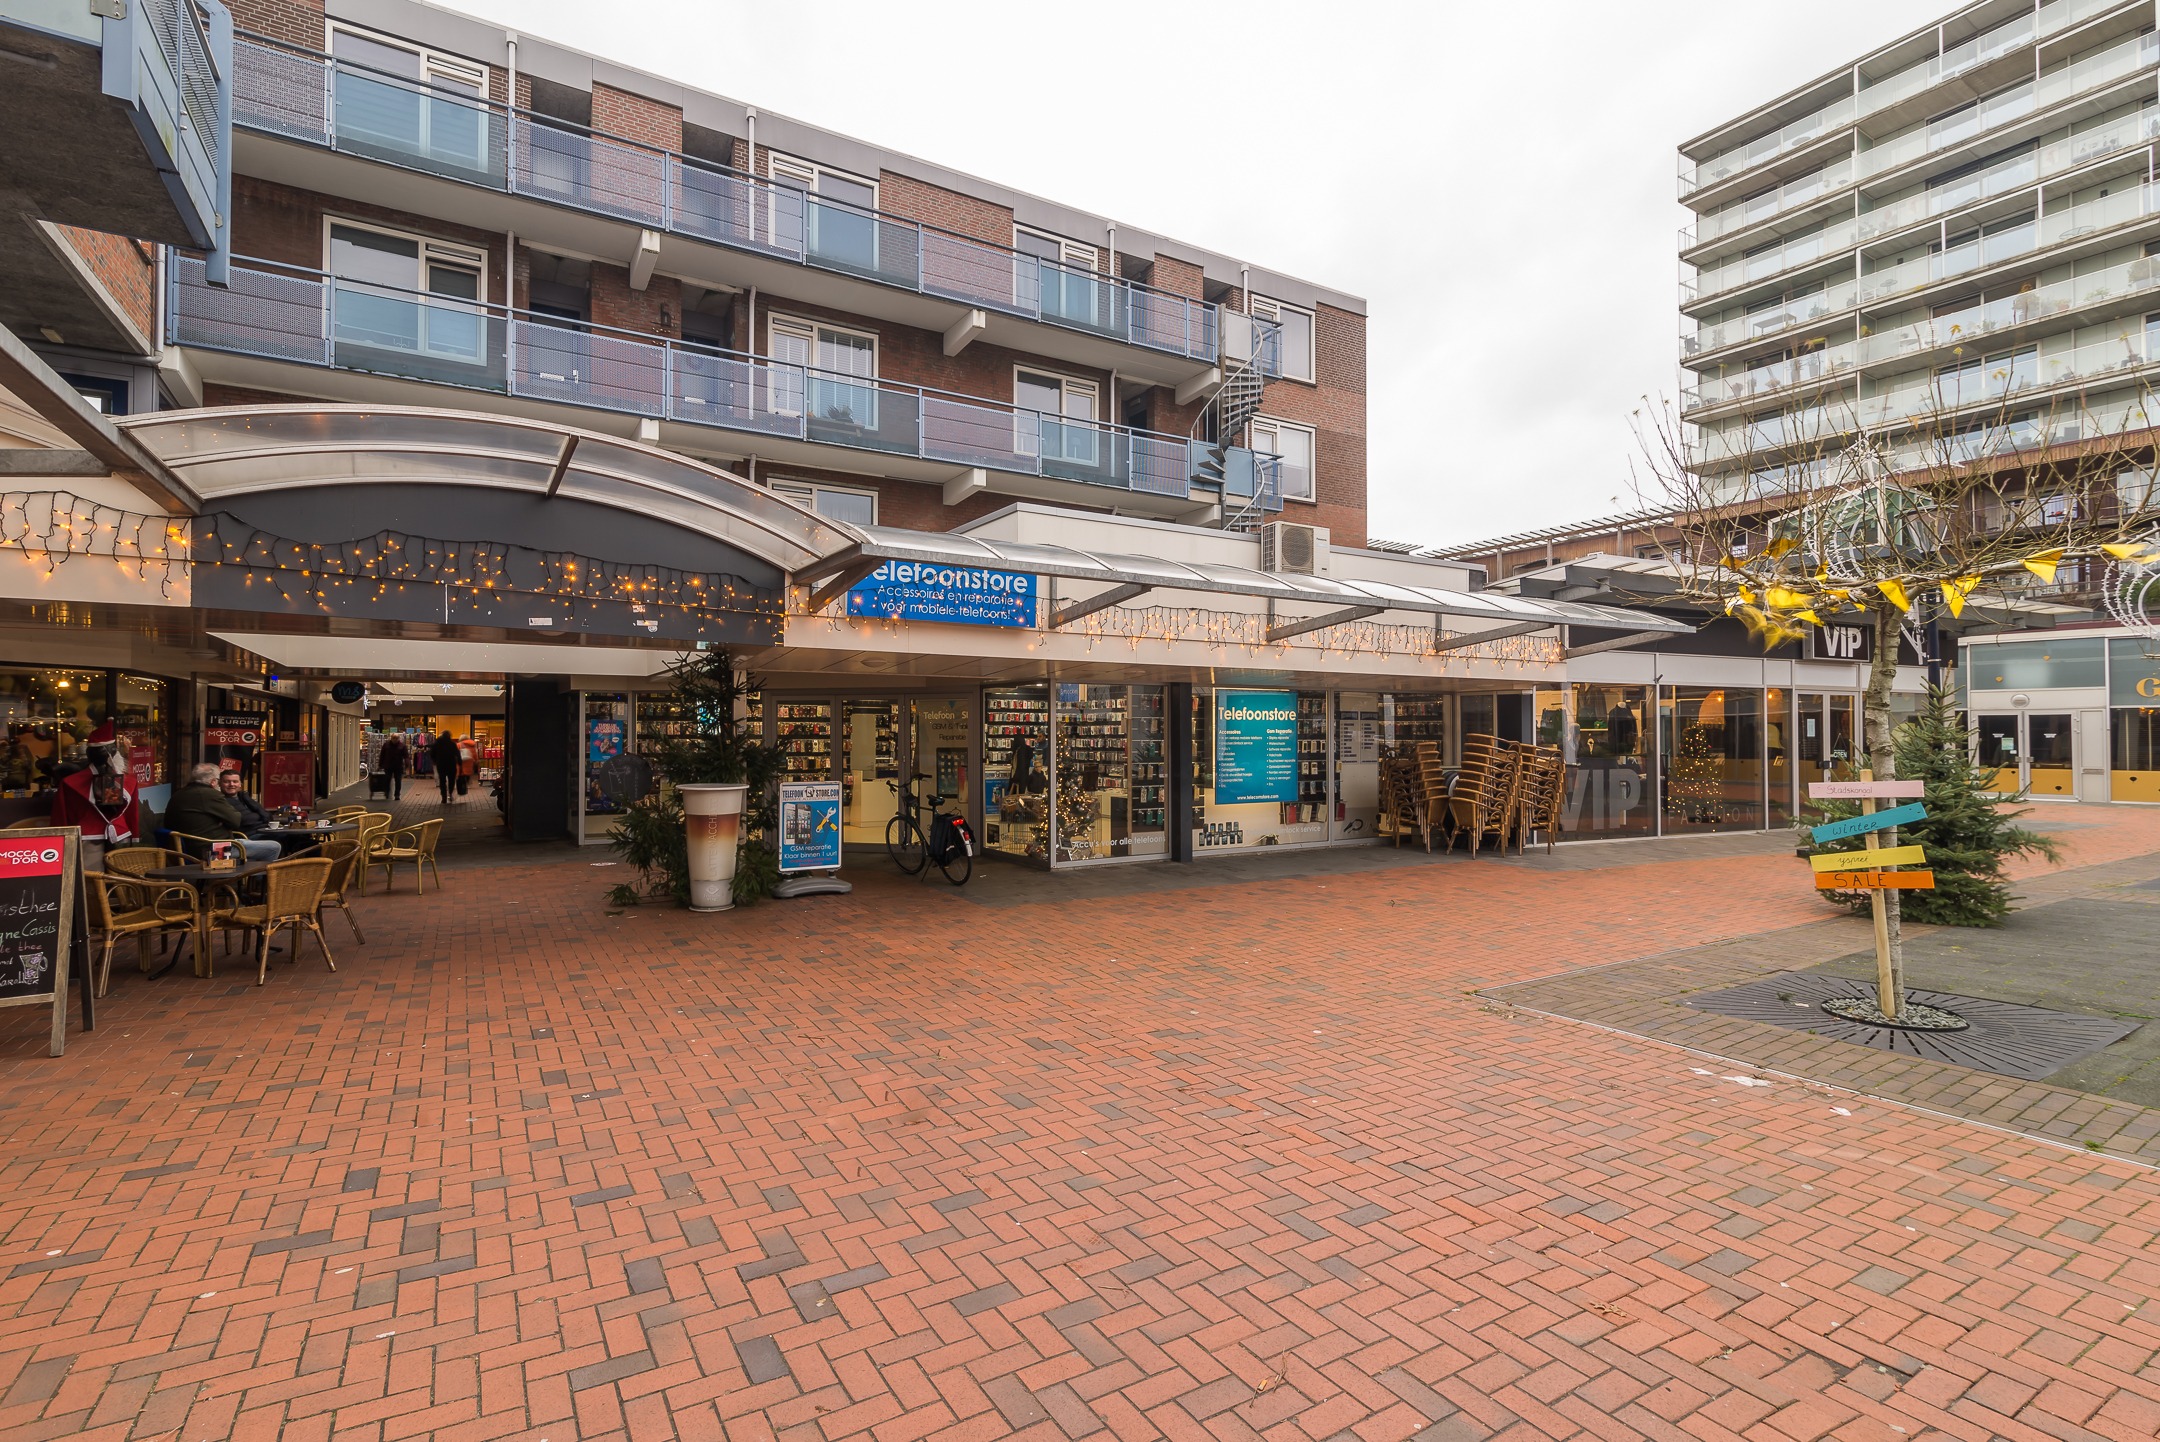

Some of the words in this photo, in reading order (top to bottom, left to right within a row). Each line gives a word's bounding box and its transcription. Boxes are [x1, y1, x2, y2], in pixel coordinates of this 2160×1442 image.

[866, 560, 1028, 593] elefoonstore
[877, 585, 945, 599] Accessoires
[948, 590, 962, 601] en
[964, 592, 1014, 606] reparatie
[880, 601, 906, 612] voor
[910, 603, 956, 616] mobiele
[1823, 626, 1862, 658] VIP
[923, 711, 955, 720] Telefoon
[1218, 706, 1296, 720] Telefoonstore
[270, 774, 307, 784] SALE
[782, 790, 804, 798] TELEFOON
[1826, 785, 1872, 794] Stadskanaal
[1560, 768, 1641, 832] VIP
[1668, 808, 1754, 825] FASHION
[1120, 838, 1132, 846] alle
[1134, 836, 1166, 844] telefoons
[12, 856, 38, 865] D'OR
[1834, 873, 1886, 887] SALE
